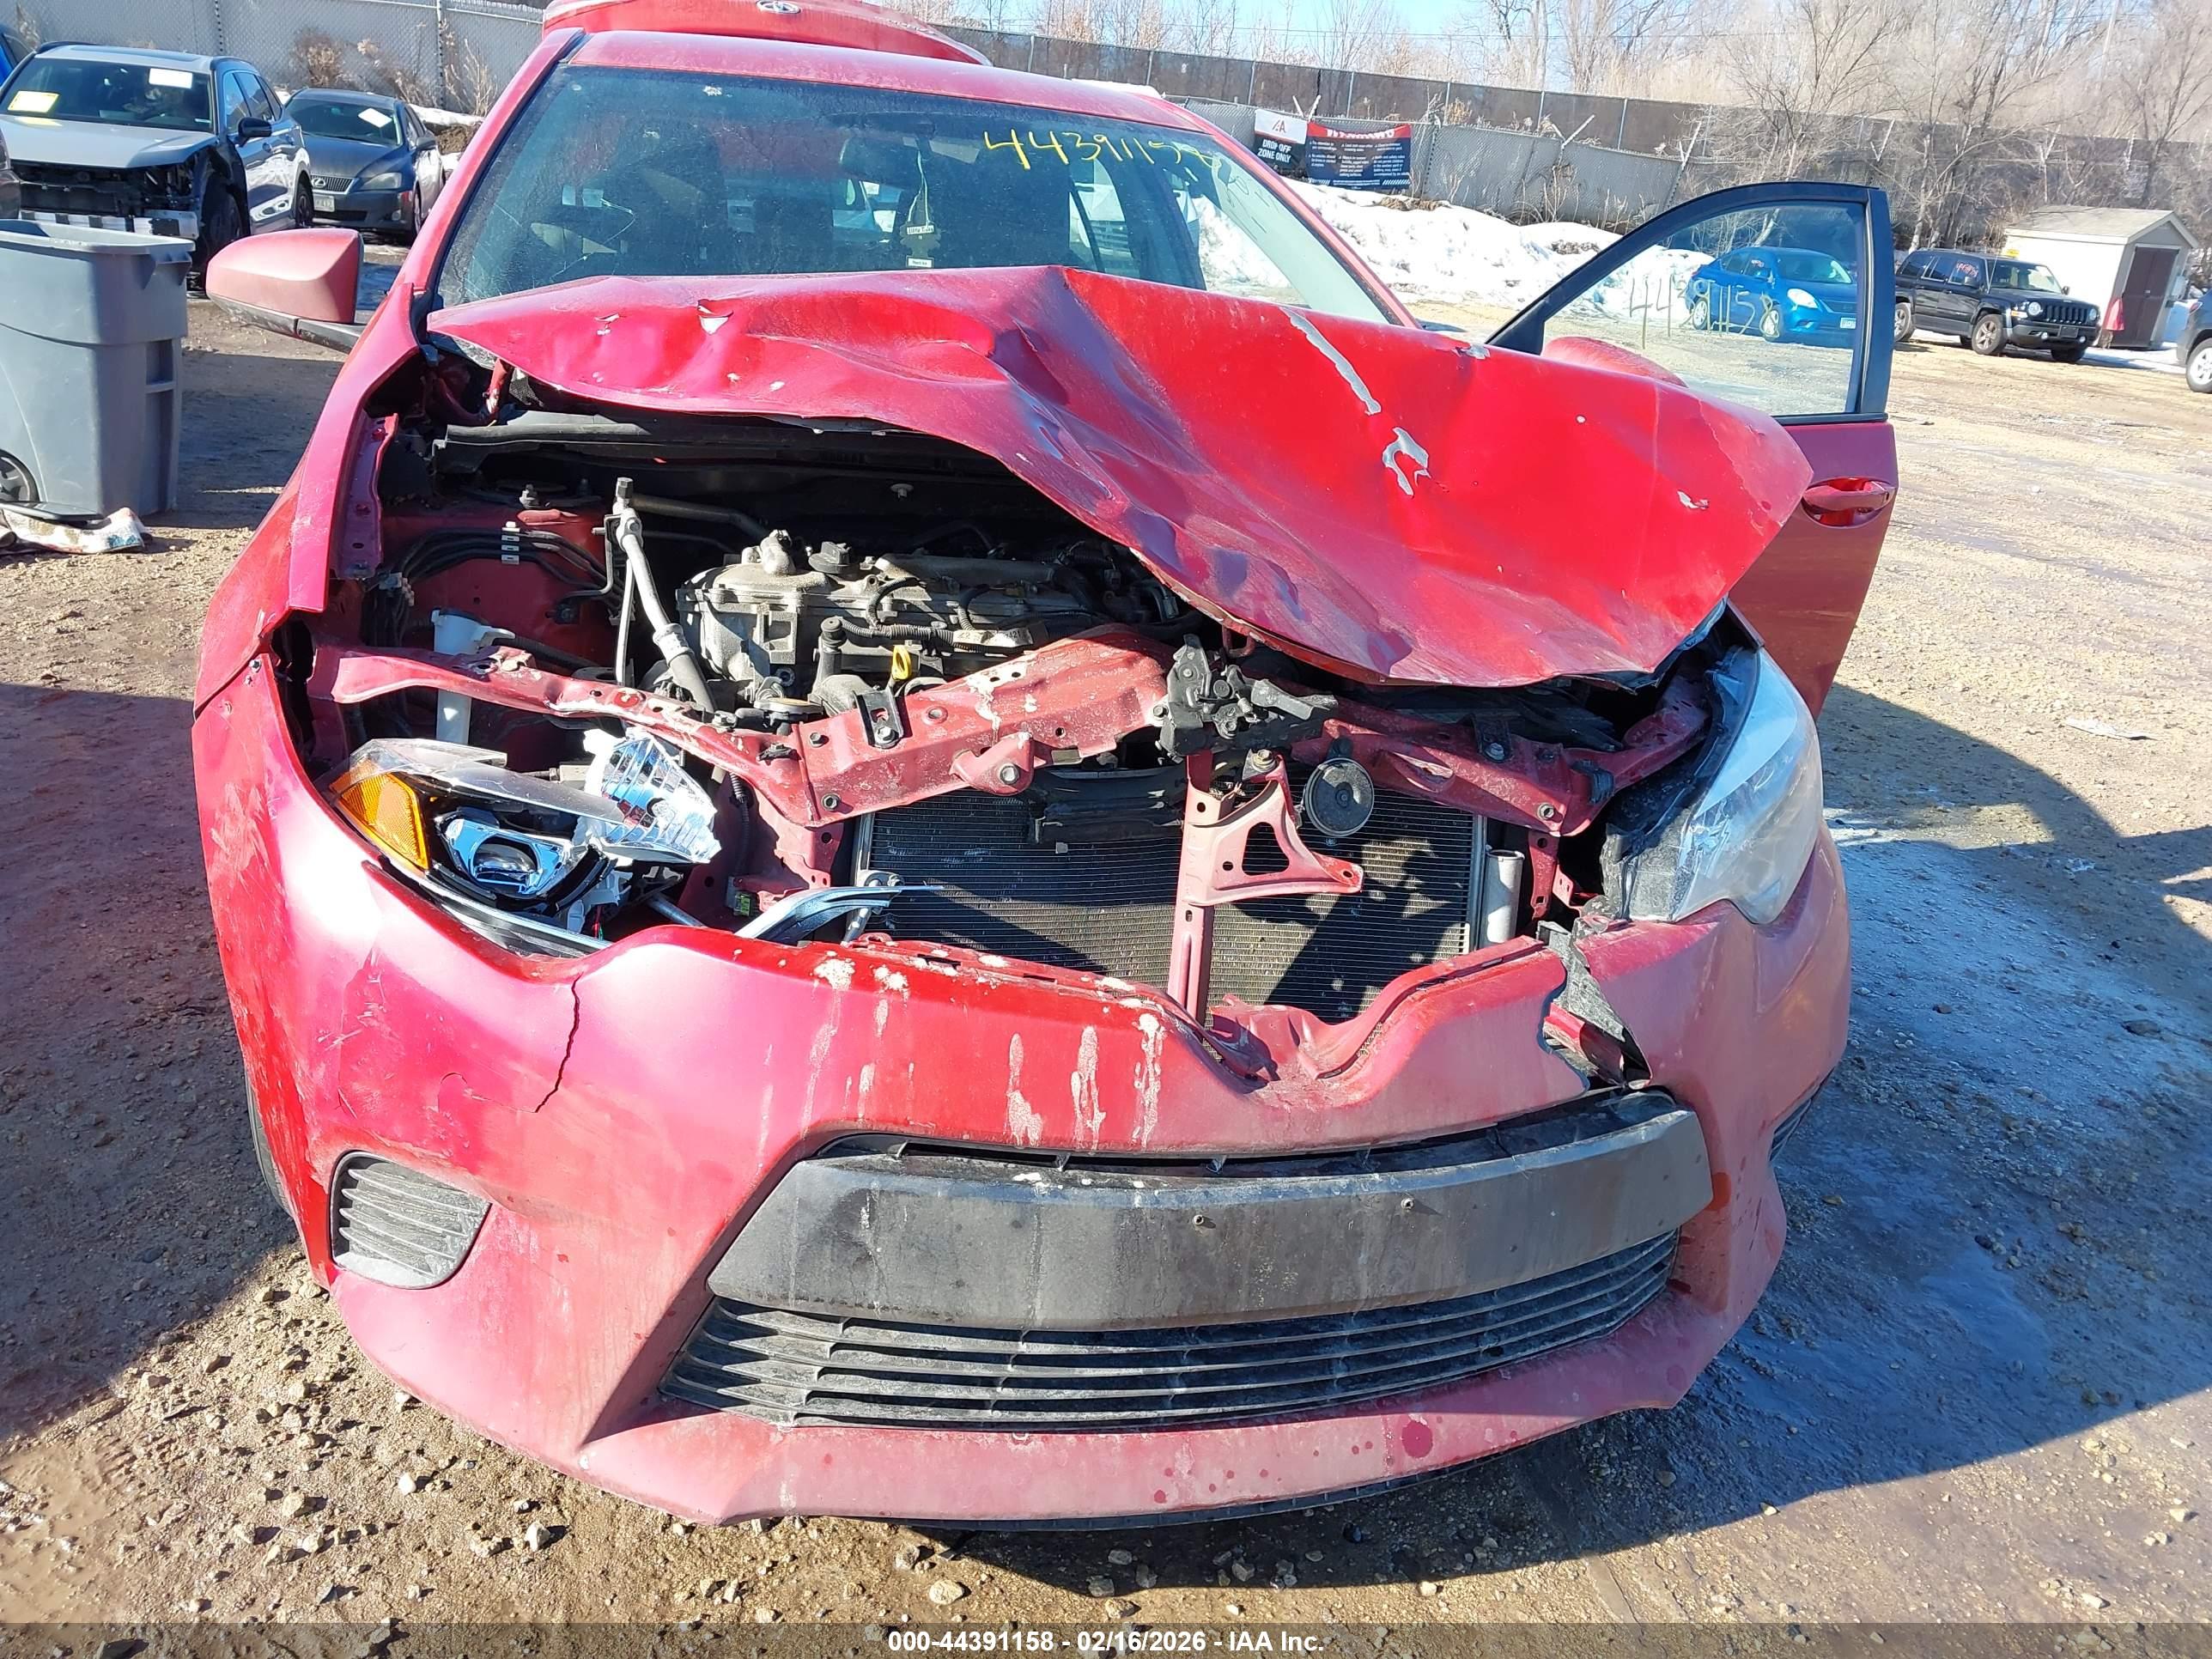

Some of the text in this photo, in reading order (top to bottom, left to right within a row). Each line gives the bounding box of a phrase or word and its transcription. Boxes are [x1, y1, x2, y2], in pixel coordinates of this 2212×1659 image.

[1262, 139, 1291, 153] DROP OFF
[1257, 148, 1291, 163] ZONE ONLY
